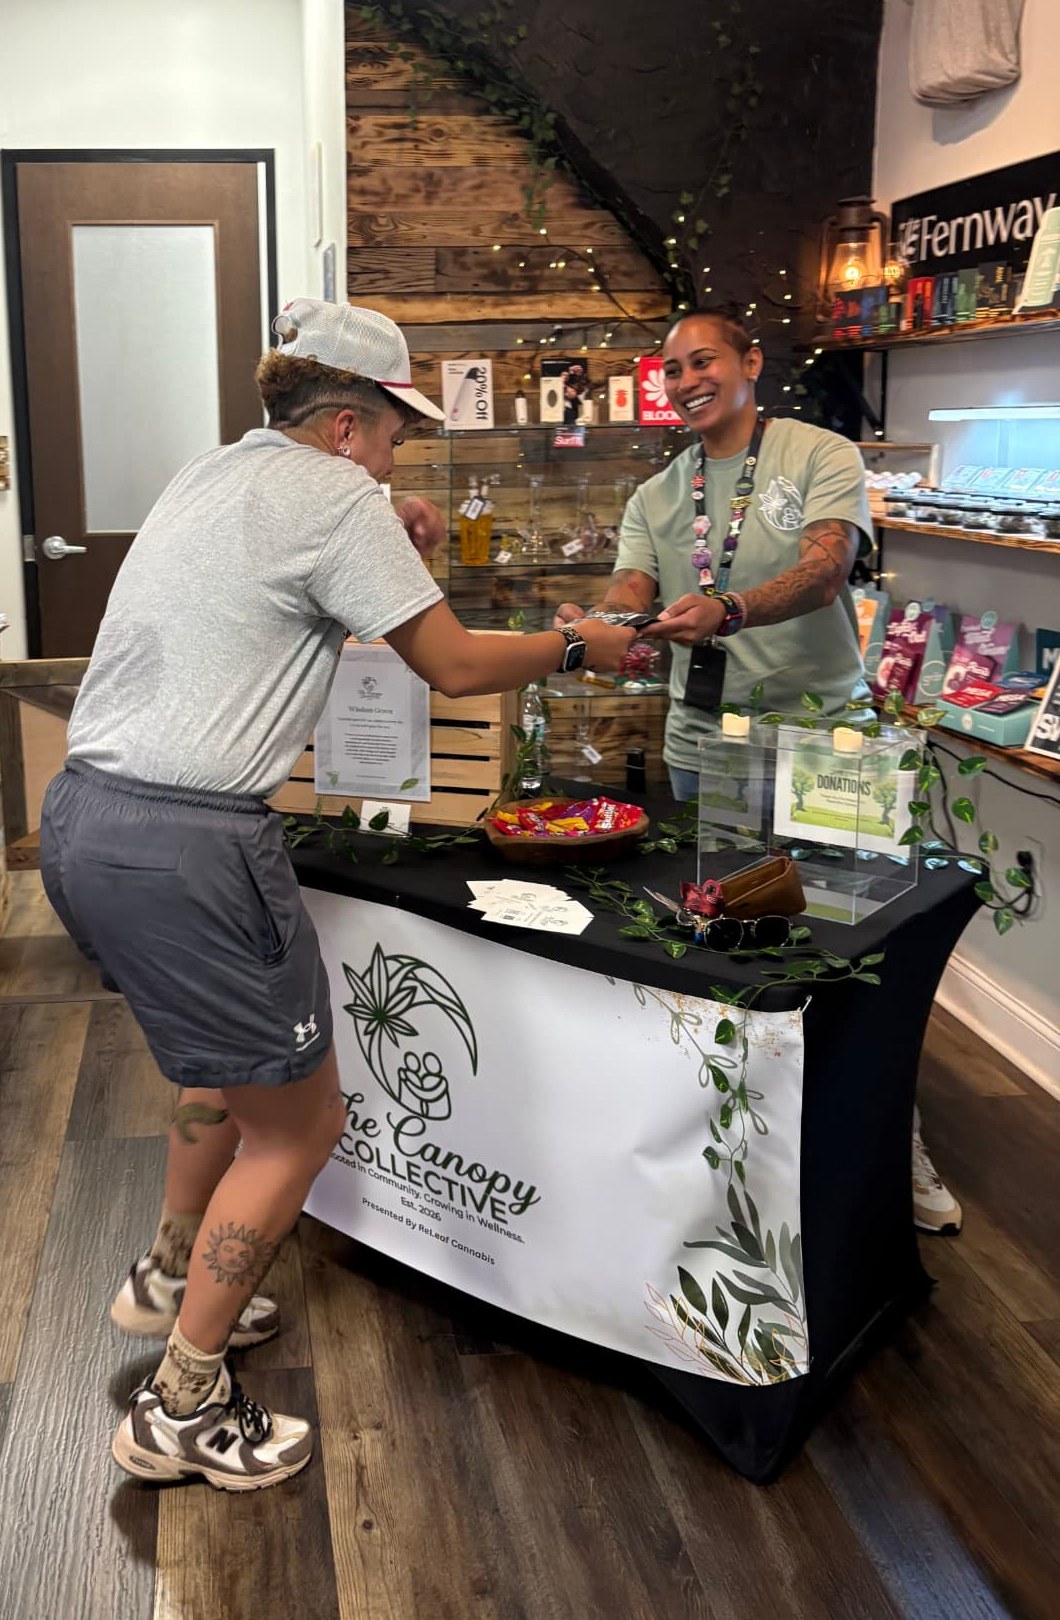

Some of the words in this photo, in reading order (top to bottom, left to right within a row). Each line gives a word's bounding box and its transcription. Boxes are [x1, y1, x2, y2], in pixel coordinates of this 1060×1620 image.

[919, 192, 1056, 261] Fernway
[475, 367, 488, 398] 20%
[475, 399, 489, 420] Off
[817, 774, 871, 796] DONATIONS
[338, 1132, 509, 1224] COLLECTIVE
[340, 1091, 381, 1138] he
[386, 1112, 541, 1215] Canopy
[357, 1162, 367, 1175] in
[465, 1210, 476, 1223] in
[419, 1204, 442, 1221] 2026
[362, 1197, 404, 1222] Presented
[405, 1216, 417, 1230] By
[418, 1223, 450, 1244] ReLeaf
[451, 1238, 496, 1265] Cannabis
